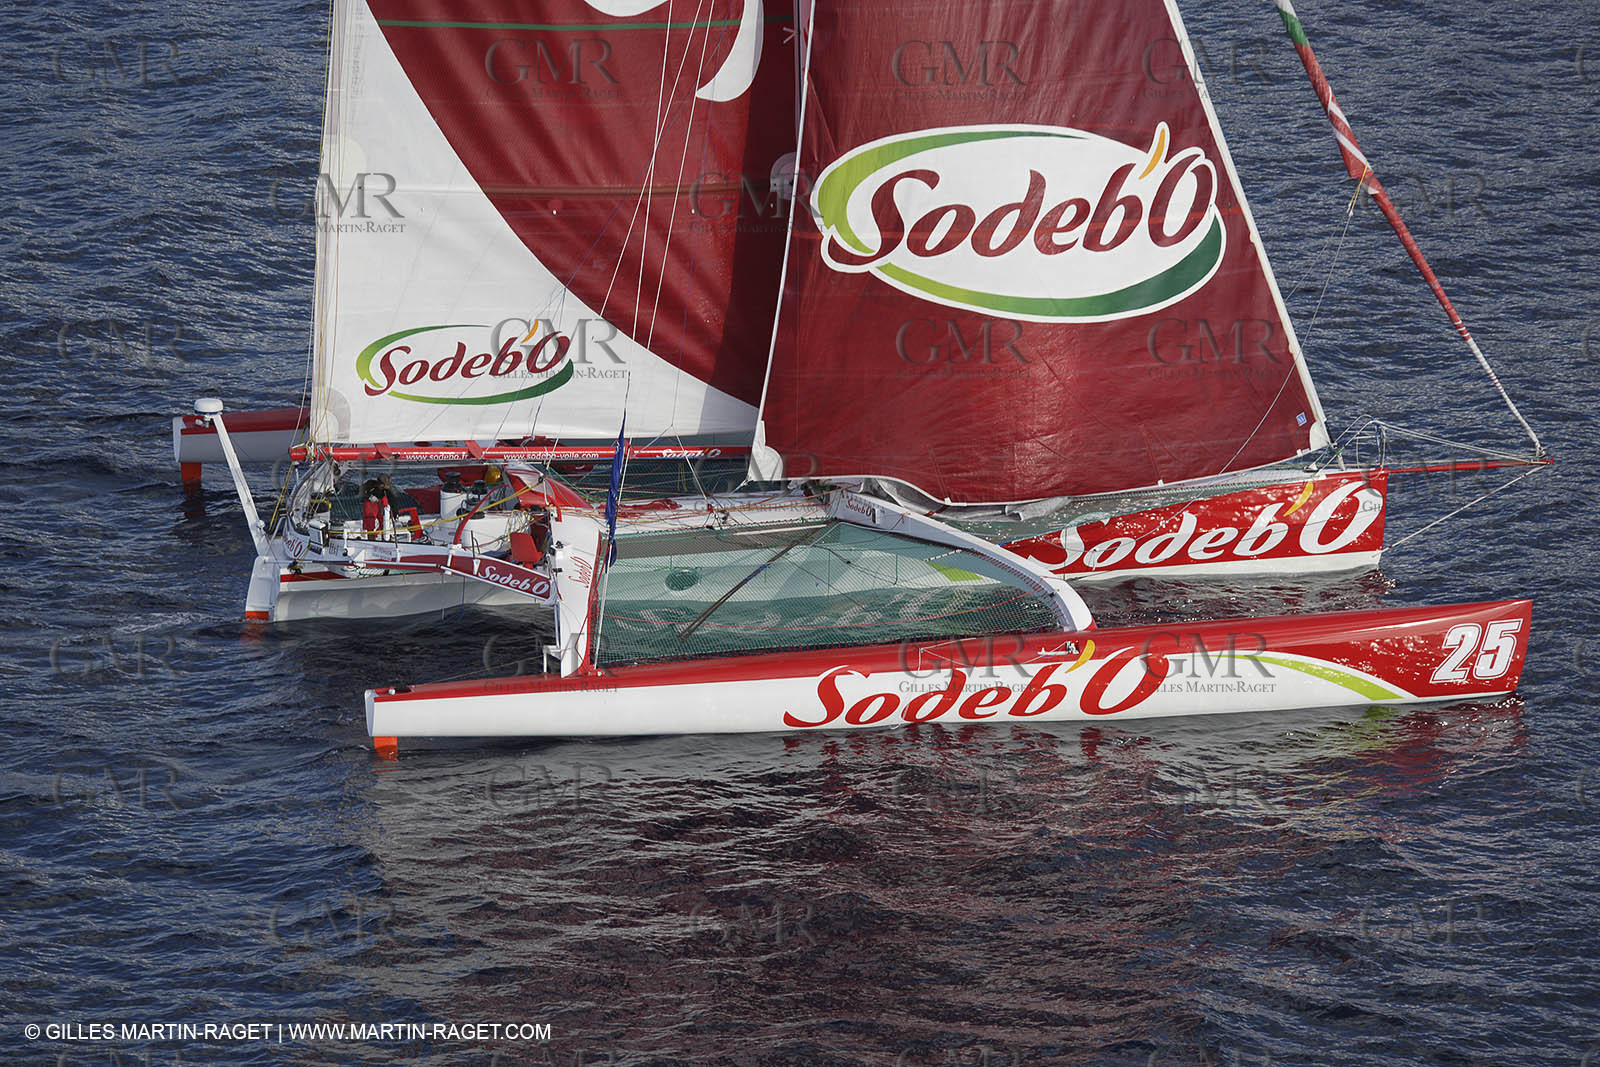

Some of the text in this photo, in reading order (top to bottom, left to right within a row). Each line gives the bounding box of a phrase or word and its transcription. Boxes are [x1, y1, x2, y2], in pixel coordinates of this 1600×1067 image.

[828, 127, 1214, 265] Sodeb'O
[365, 320, 571, 396] Sodeb'O
[783, 640, 1169, 728] Sodeb'O
[1430, 618, 1523, 684] 25
